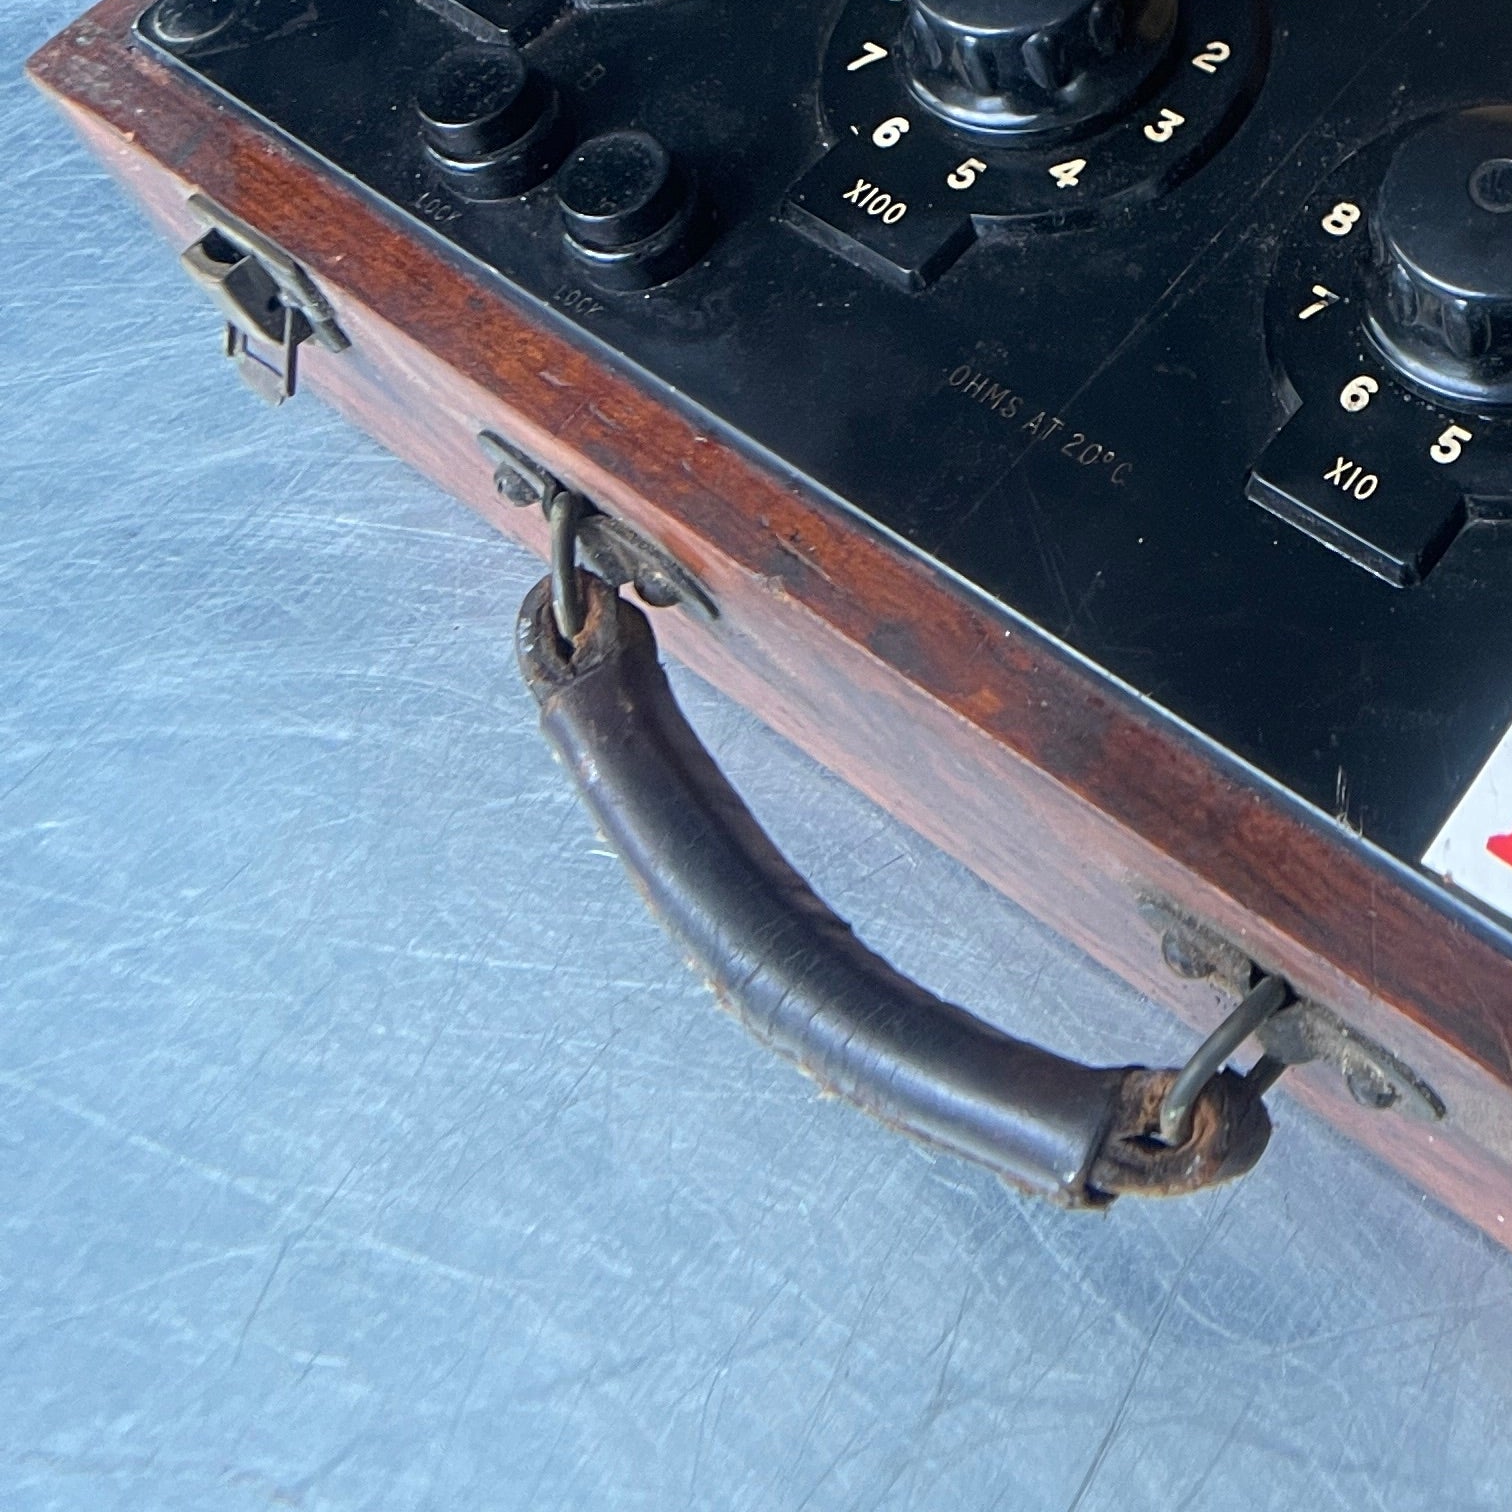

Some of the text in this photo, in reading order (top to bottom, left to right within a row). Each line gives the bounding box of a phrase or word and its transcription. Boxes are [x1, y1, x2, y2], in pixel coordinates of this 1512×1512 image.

[847, 41, 888, 71] 7
[1192, 41, 1231, 73] 2
[872, 116, 910, 148] 6
[1144, 108, 1185, 143] 3
[946, 157, 987, 189] 5
[1048, 158, 1087, 188] 4
[413, 191, 464, 223] LOCK
[842, 178, 907, 224] X100
[1320, 202, 1361, 236] 8
[1298, 284, 1340, 321] 7
[1339, 374, 1379, 412] 6
[950, 364, 1133, 485] OHMS AT 20°C
[1429, 424, 1473, 464] 5
[1322, 456, 1379, 501] X10
